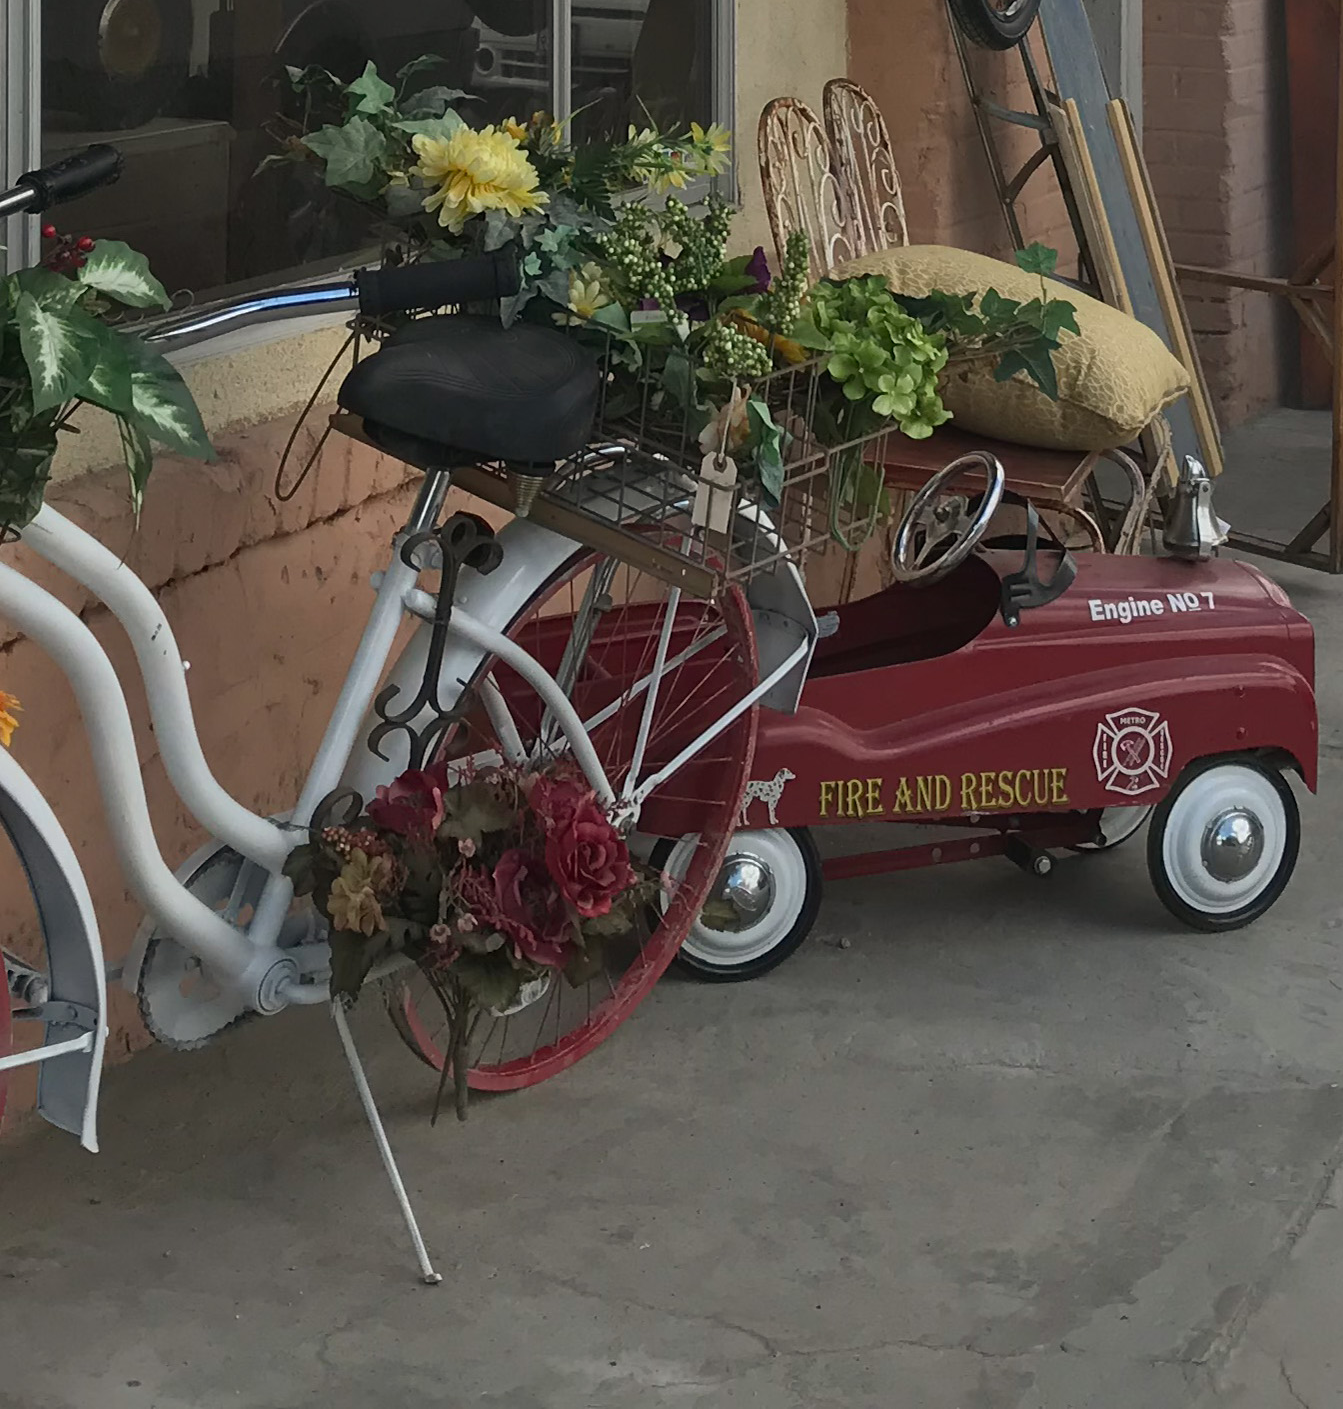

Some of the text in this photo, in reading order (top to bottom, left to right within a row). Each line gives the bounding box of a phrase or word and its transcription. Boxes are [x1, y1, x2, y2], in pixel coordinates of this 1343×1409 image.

[1088, 596, 1164, 624] Engine
[1199, 591, 1216, 610] 7
[1119, 716, 1147, 726] METRO
[819, 767, 1070, 818] FIRE AND RESCUE
